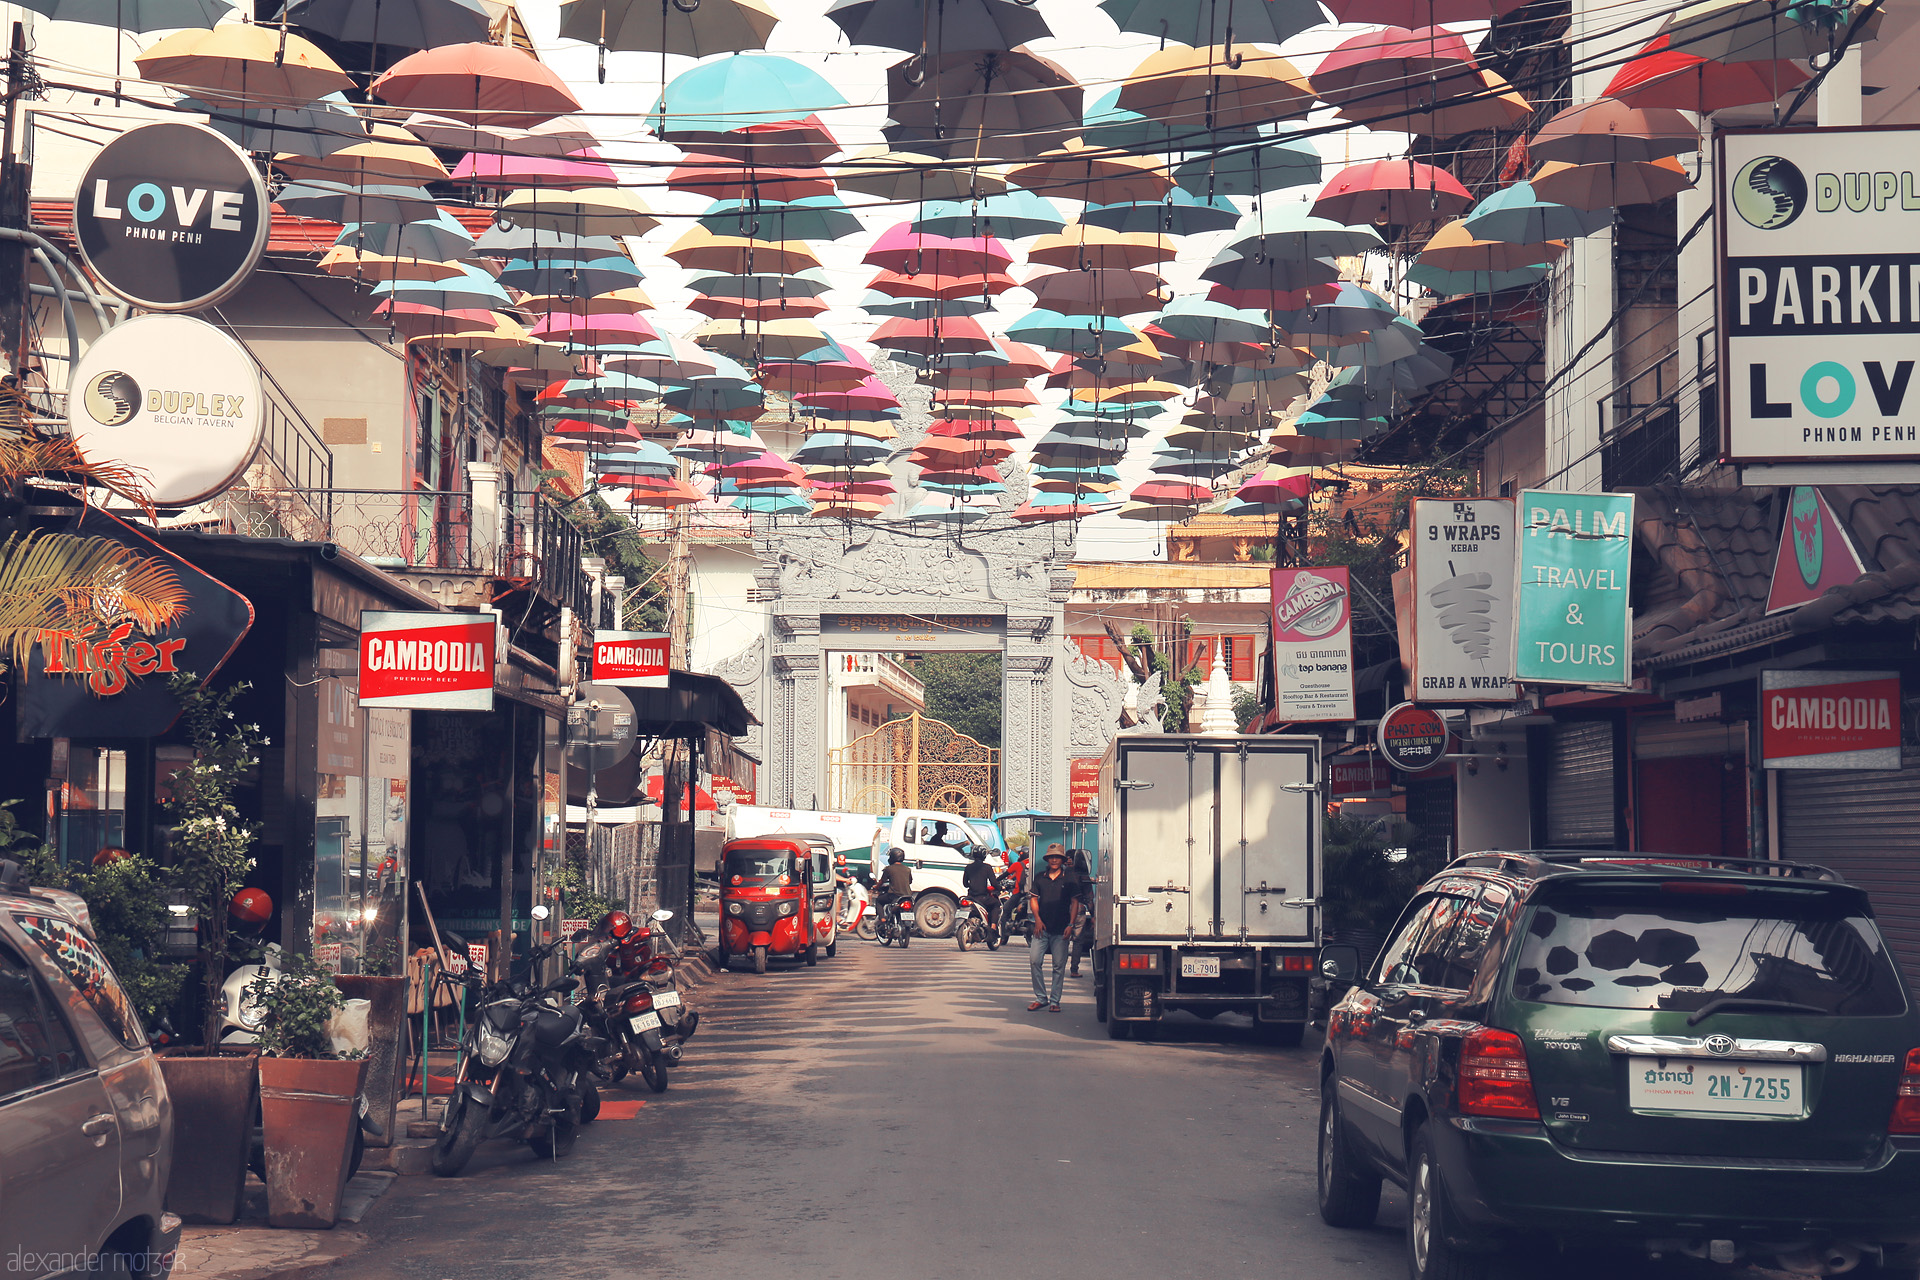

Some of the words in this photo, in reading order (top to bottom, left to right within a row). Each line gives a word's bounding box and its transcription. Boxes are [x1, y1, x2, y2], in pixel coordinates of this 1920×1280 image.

[92, 178, 245, 232] LOVE
[125, 226, 166, 241] PHNOM
[171, 230, 203, 244] PENH
[146, 389, 245, 419] DUPLEX
[154, 414, 194, 425] BELGIAN
[197, 417, 235, 428] TAVERN
[1803, 427, 1862, 442] PHNOM
[1872, 426, 1916, 441] PENH
[1428, 525, 1438, 540] 9
[1443, 525, 1500, 540] WRAPS
[1530, 507, 1626, 541] PALM
[1451, 544, 1479, 552] KEBAB
[1532, 565, 1621, 590] TRAVEL
[1278, 582, 1345, 622] CAMBODIA
[1566, 603, 1584, 625] &
[368, 637, 485, 673] CAMBODIA
[598, 645, 664, 667] CAMBODIA
[1535, 641, 1616, 666] TOURS
[1298, 664, 1314, 674] top
[1315, 663, 1347, 672] banana
[1422, 676, 1455, 689] GRAB
[1458, 677, 1467, 688] A
[327, 680, 355, 728] LOVE
[1771, 695, 1891, 731] CAMBODIA
[1387, 723, 1416, 736] PHAT
[1419, 722, 1441, 735] COW
[1544, 1041, 1582, 1050] TOYOTA
[1834, 1054, 1895, 1063] HIGHLANDER
[1551, 1097, 1570, 1107] V6
